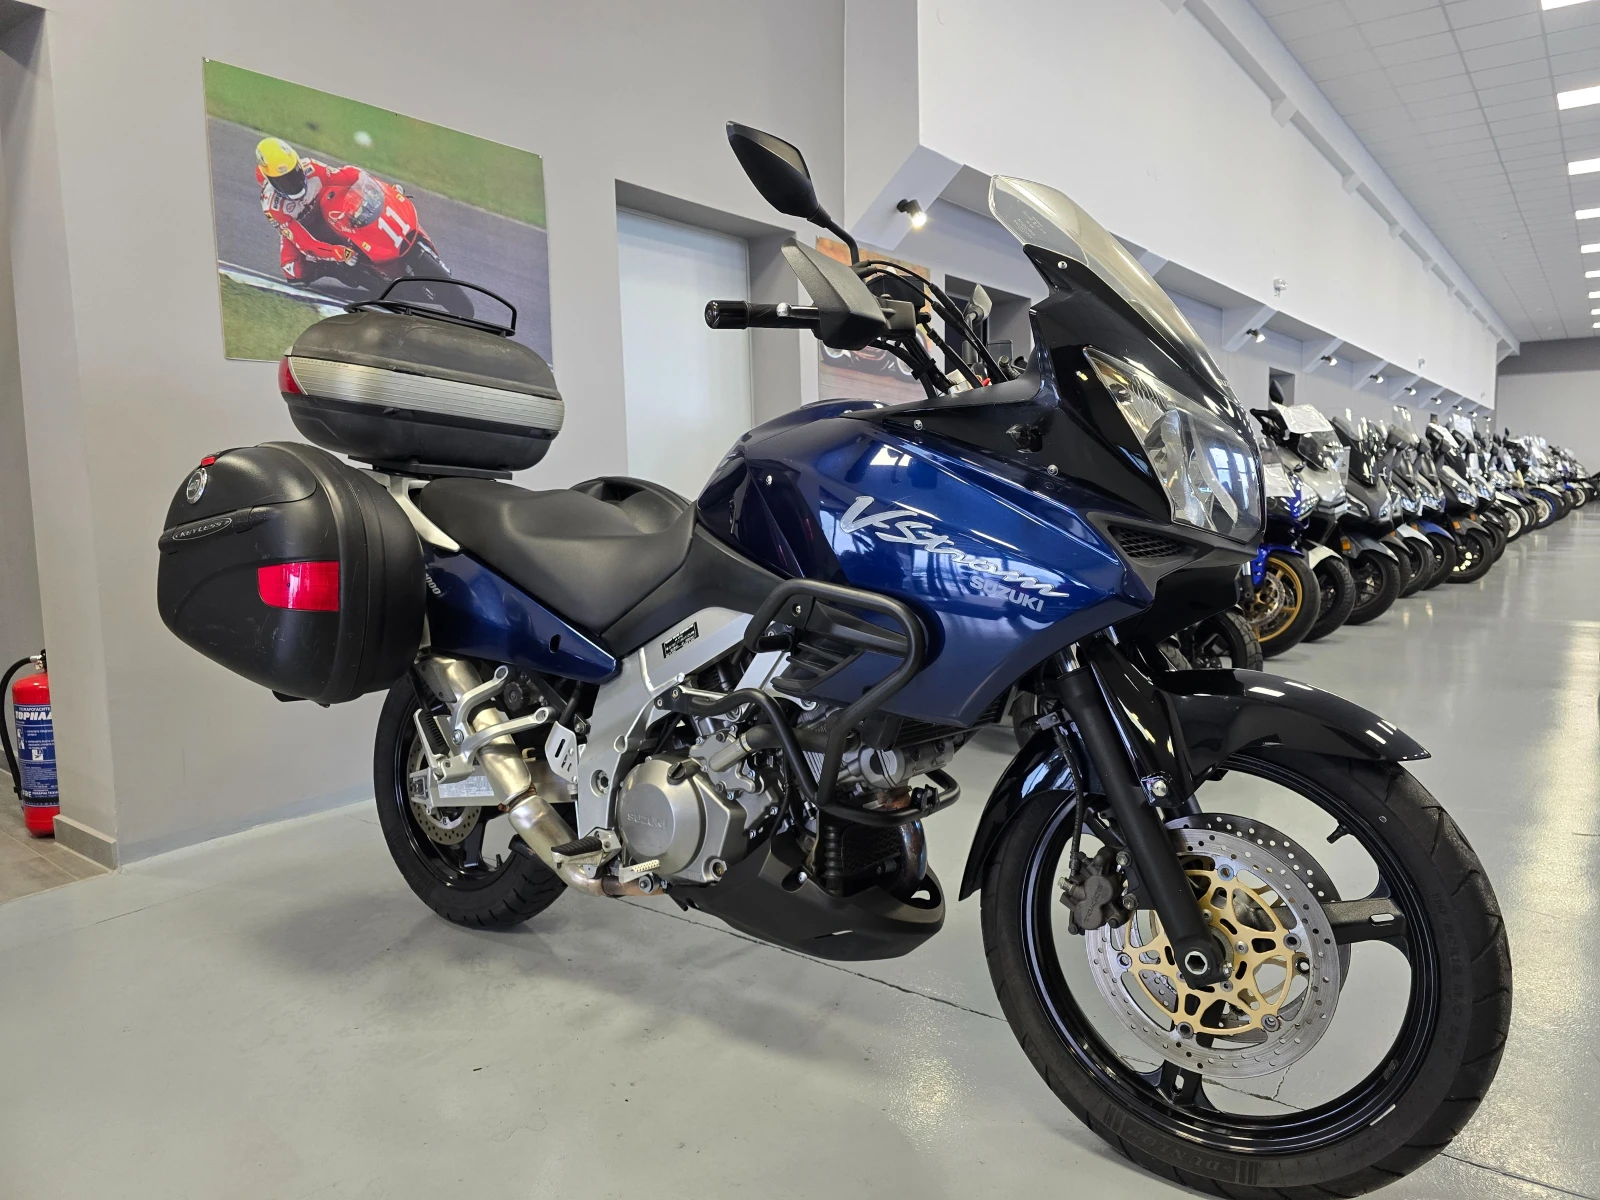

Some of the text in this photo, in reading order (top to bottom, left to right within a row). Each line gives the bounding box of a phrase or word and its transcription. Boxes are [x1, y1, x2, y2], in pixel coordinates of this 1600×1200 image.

[378, 206, 411, 248] 11
[180, 521, 222, 538] KEYLESS
[969, 575, 1045, 613] SUZUKI
[627, 813, 668, 829] SUZUKI
[1127, 1128, 1222, 1172] DUNLOP
